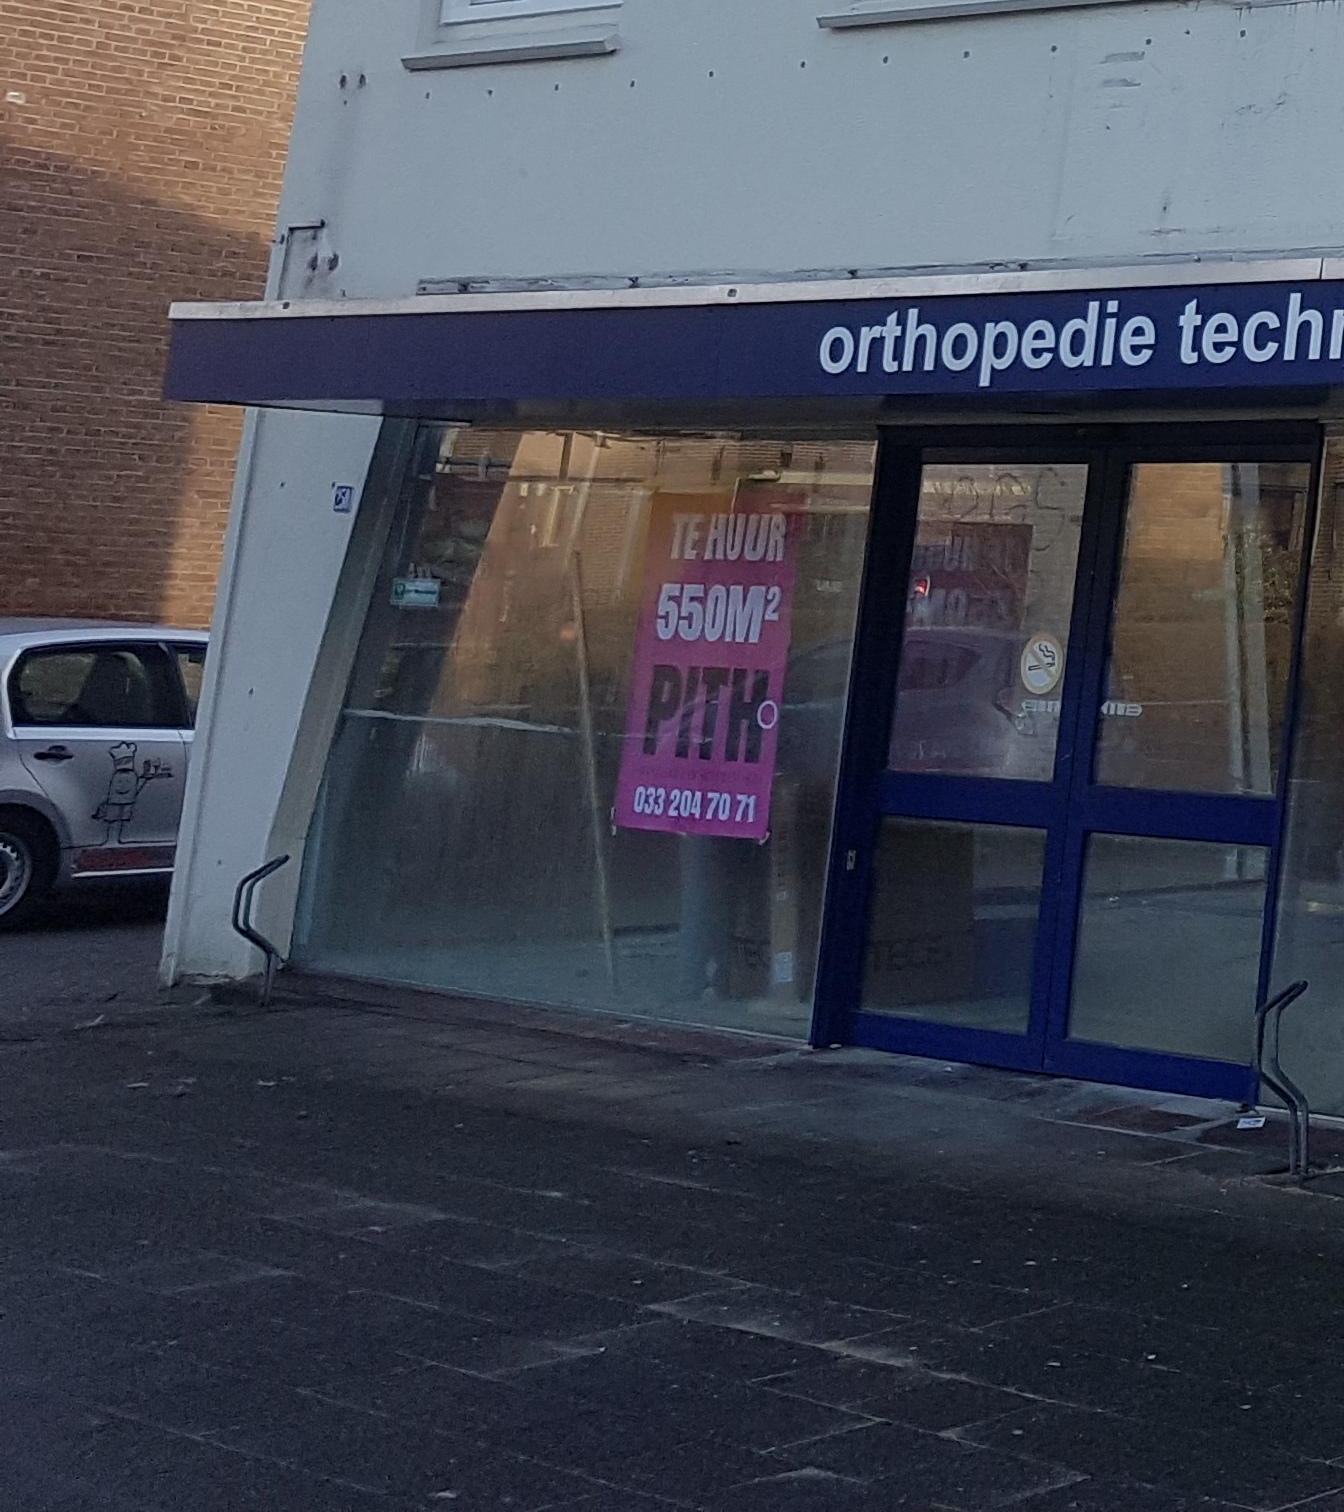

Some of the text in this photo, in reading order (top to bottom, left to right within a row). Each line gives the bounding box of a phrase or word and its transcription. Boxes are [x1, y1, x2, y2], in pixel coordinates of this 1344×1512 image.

[819, 299, 1156, 387] orthopedie
[670, 513, 787, 562] TE HUUR
[643, 664, 770, 764] PITH
[633, 786, 757, 823] 033 204 70 71
